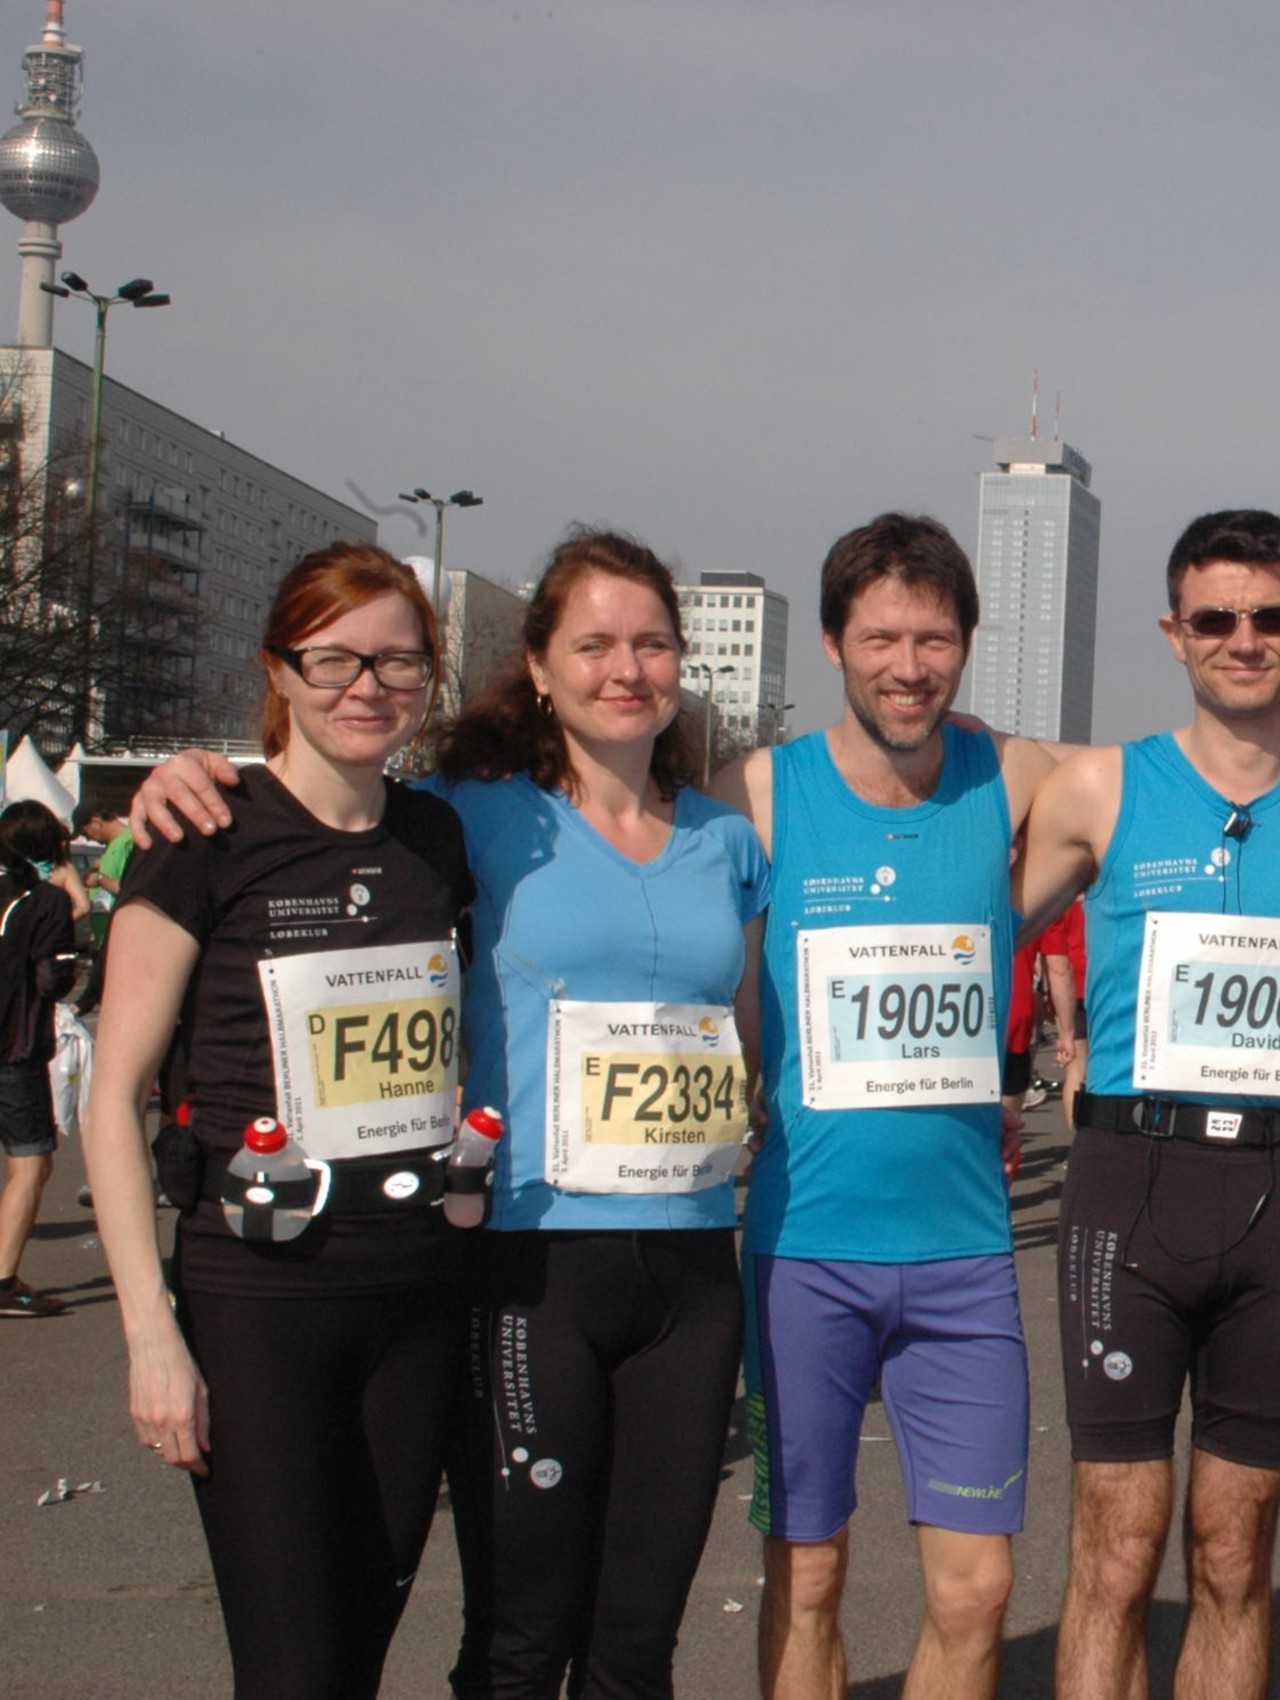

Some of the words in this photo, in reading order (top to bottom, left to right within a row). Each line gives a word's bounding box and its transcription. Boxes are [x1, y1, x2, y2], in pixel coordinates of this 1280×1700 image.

[268, 897, 339, 909] KØBENHAVNS
[269, 906, 339, 918] UNIVERSITET
[270, 928, 329, 940] LØBEKLUB
[849, 944, 947, 958] VATTENFALL
[325, 967, 423, 988] VATTENFALL
[1175, 964, 1190, 982] E
[831, 980, 845, 999] E
[270, 979, 287, 1048] HALBMARATHON
[851, 983, 984, 1040] 19050
[309, 1014, 326, 1035] D
[607, 1023, 697, 1037] VATTENFALL
[804, 1010, 812, 1044] BERLINER
[333, 1007, 455, 1082] F498
[553, 1019, 562, 1084] HALBMARATHON
[901, 1044, 940, 1059] Lars
[280, 1050, 292, 1090] BERLINER
[586, 1057, 601, 1076] E
[1200, 1065, 1249, 1082] Energie
[1253, 1068, 1271, 1081] für
[379, 1079, 434, 1099] Hanne
[601, 1063, 734, 1123] F2334
[866, 1080, 915, 1094] Energie
[920, 1079, 937, 1090] für
[941, 1077, 973, 1089] Berlin
[552, 1085, 561, 1123] BERLINER
[357, 1121, 407, 1140] Energie
[411, 1118, 427, 1132] für
[644, 1127, 705, 1143] Kirsten
[552, 1124, 560, 1159] Vattenfall
[561, 1149, 569, 1165] April
[618, 1165, 669, 1180] Energie
[673, 1164, 688, 1177] für
[1091, 1230, 1105, 1329] UNIVERSITET
[1101, 1231, 1118, 1331] KØBENHAVNS
[501, 1314, 522, 1433] UNIVERSITET
[516, 1317, 537, 1435] KØBENHAVNS
[956, 1485, 1003, 1499] NEWLINE
